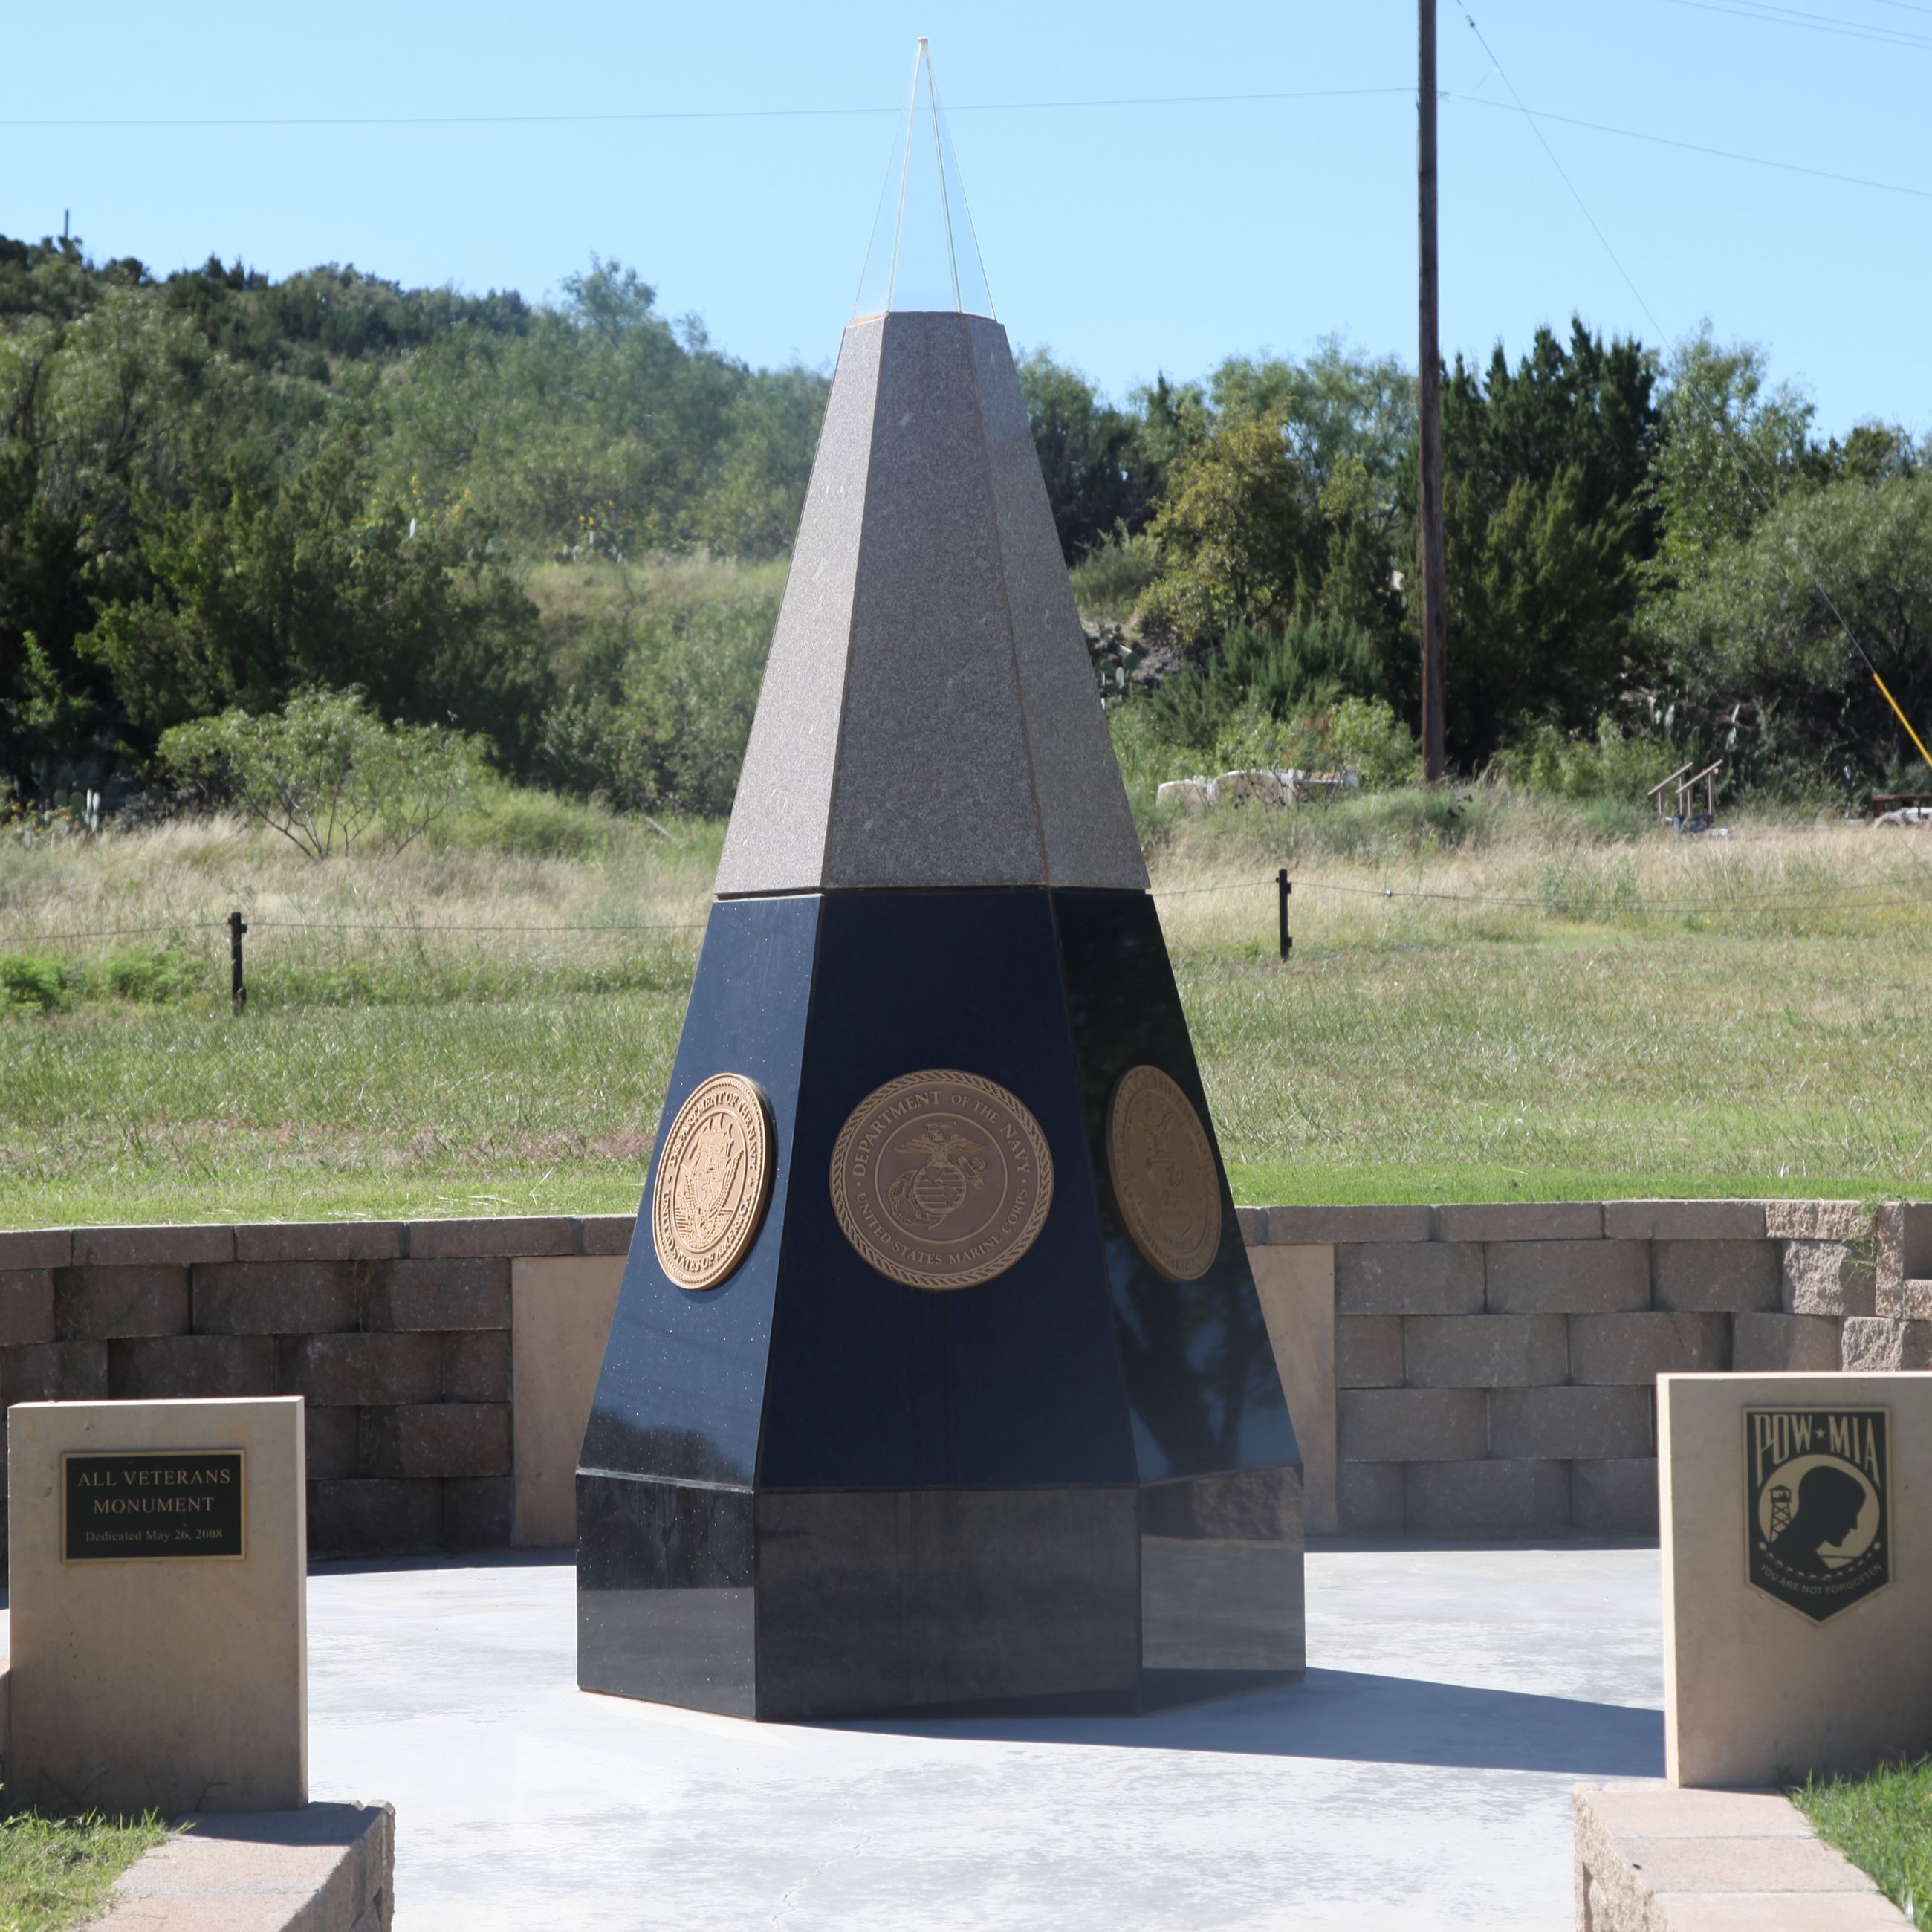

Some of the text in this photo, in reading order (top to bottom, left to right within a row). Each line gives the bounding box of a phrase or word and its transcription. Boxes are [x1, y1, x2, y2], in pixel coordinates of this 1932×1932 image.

[725, 1091, 739, 1106] OF
[852, 1090, 1031, 1177] DEPARTMENT OF THE NAVY
[856, 1189, 1027, 1265] UNITED STATES MARINE CORPS
[702, 1254, 716, 1269] OF
[1754, 1414, 1881, 1490] POW MIA
[78, 1468, 231, 1487] ALL VETERANS
[94, 1497, 215, 1514] MONUMENT
[85, 1528, 223, 1543] Dedicated May 26, 2008
[1760, 1563, 1882, 1595] YOU ARE NOT FORGOTTEN
